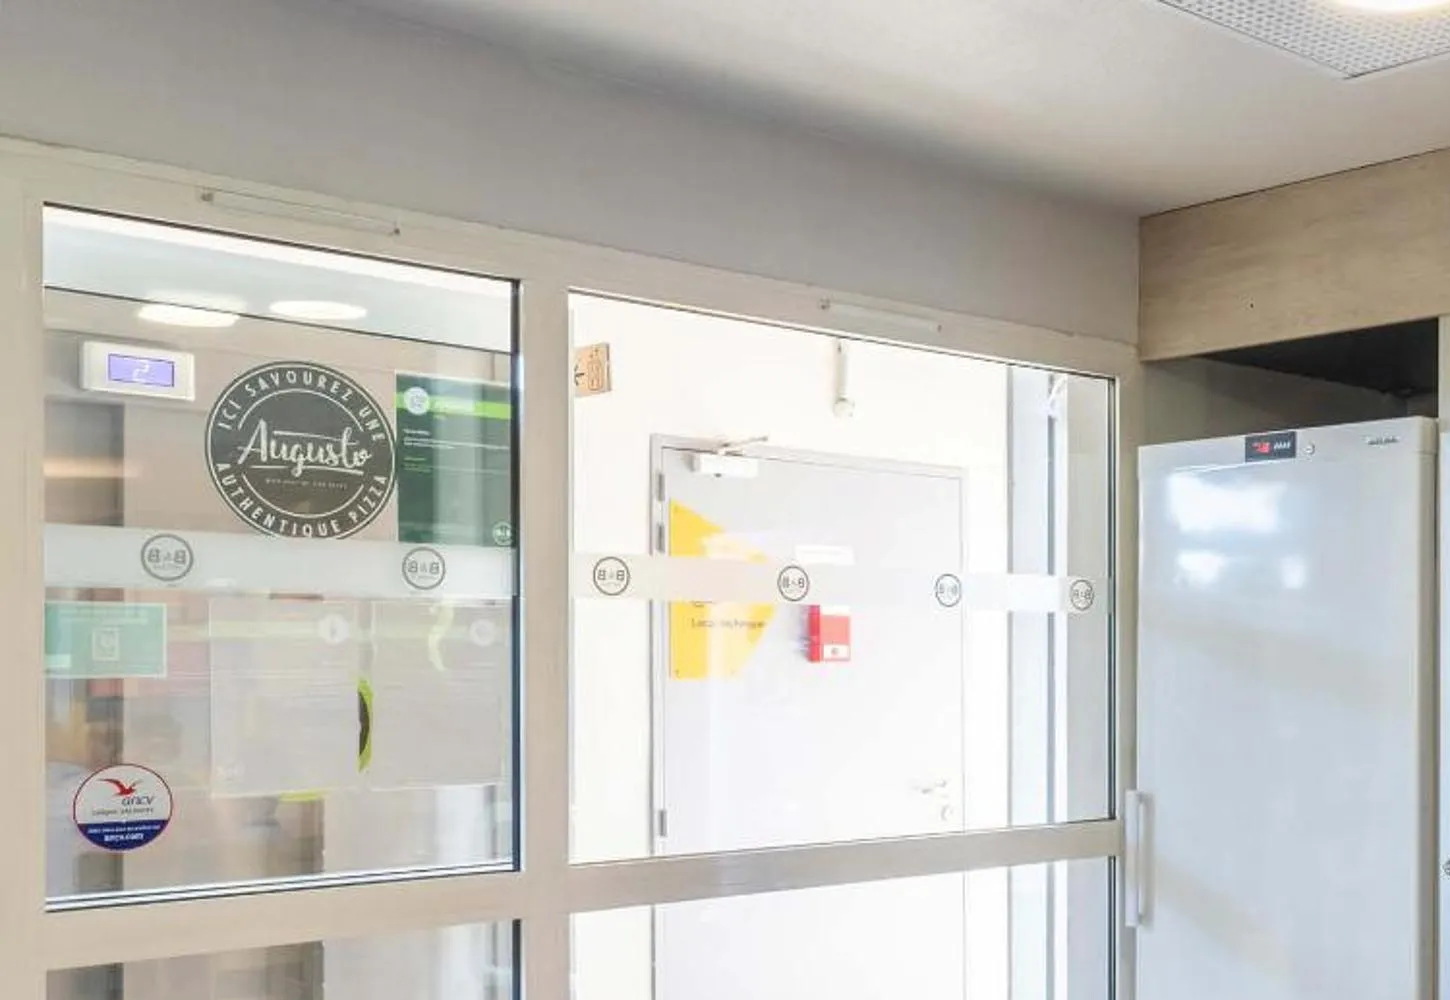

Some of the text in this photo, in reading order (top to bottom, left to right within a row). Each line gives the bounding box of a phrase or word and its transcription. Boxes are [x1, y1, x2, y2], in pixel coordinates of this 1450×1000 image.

[217, 370, 387, 442] ICI SAVOUREZ UNE
[216, 462, 388, 538] AUTHENTIQUE PIZZA
